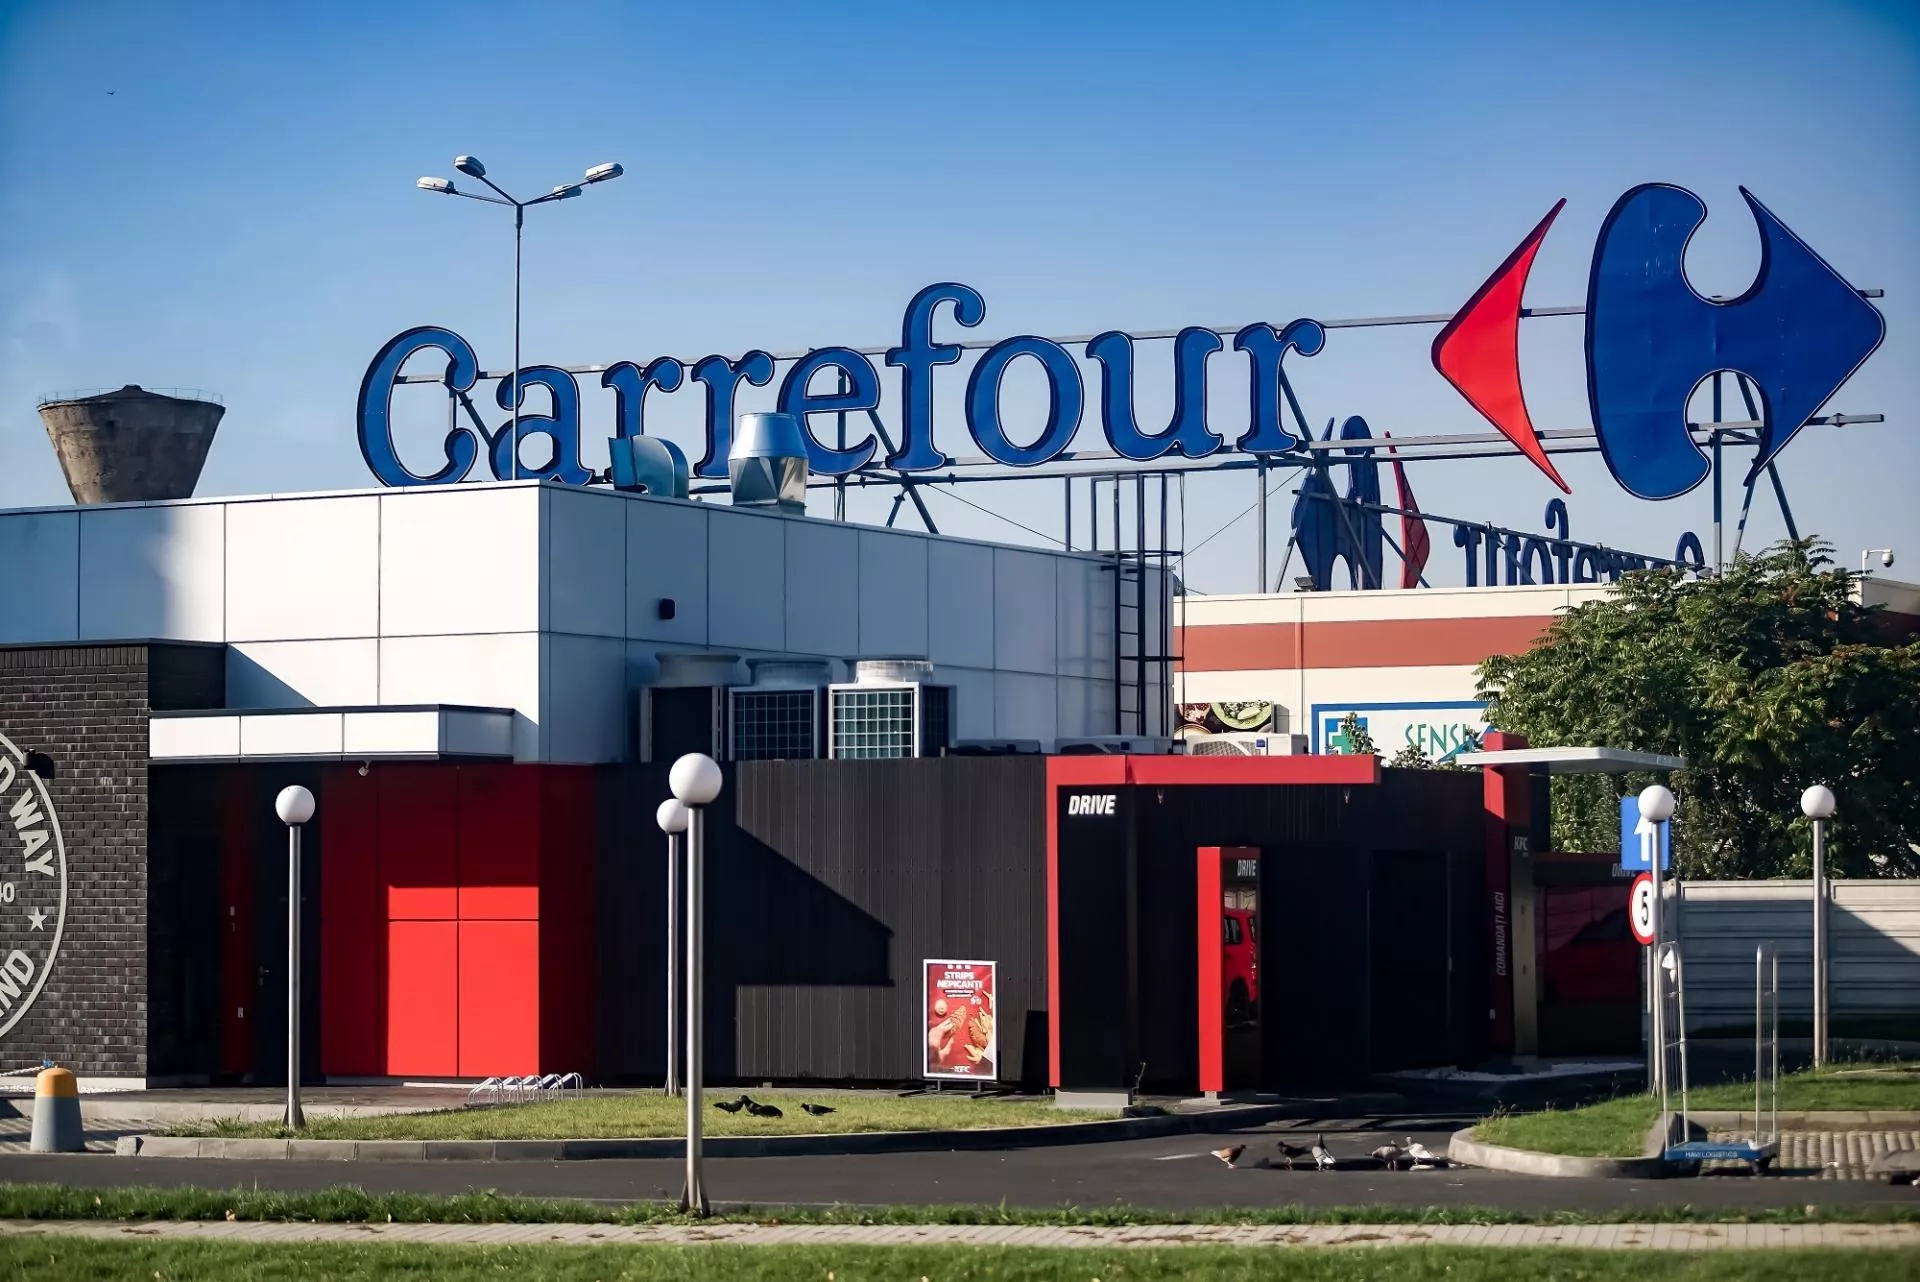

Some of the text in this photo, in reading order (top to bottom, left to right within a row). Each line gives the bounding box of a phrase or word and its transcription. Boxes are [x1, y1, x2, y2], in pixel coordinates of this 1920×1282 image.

[357, 282, 1327, 488] Carrefour
[1068, 794, 1117, 815] DRIVE
[9, 787, 55, 877] WAY
[1514, 835, 1528, 851] KFC
[1237, 859, 1256, 876] DRIVE
[1641, 890, 1649, 926] 5
[944, 971, 975, 980] STRIPS
